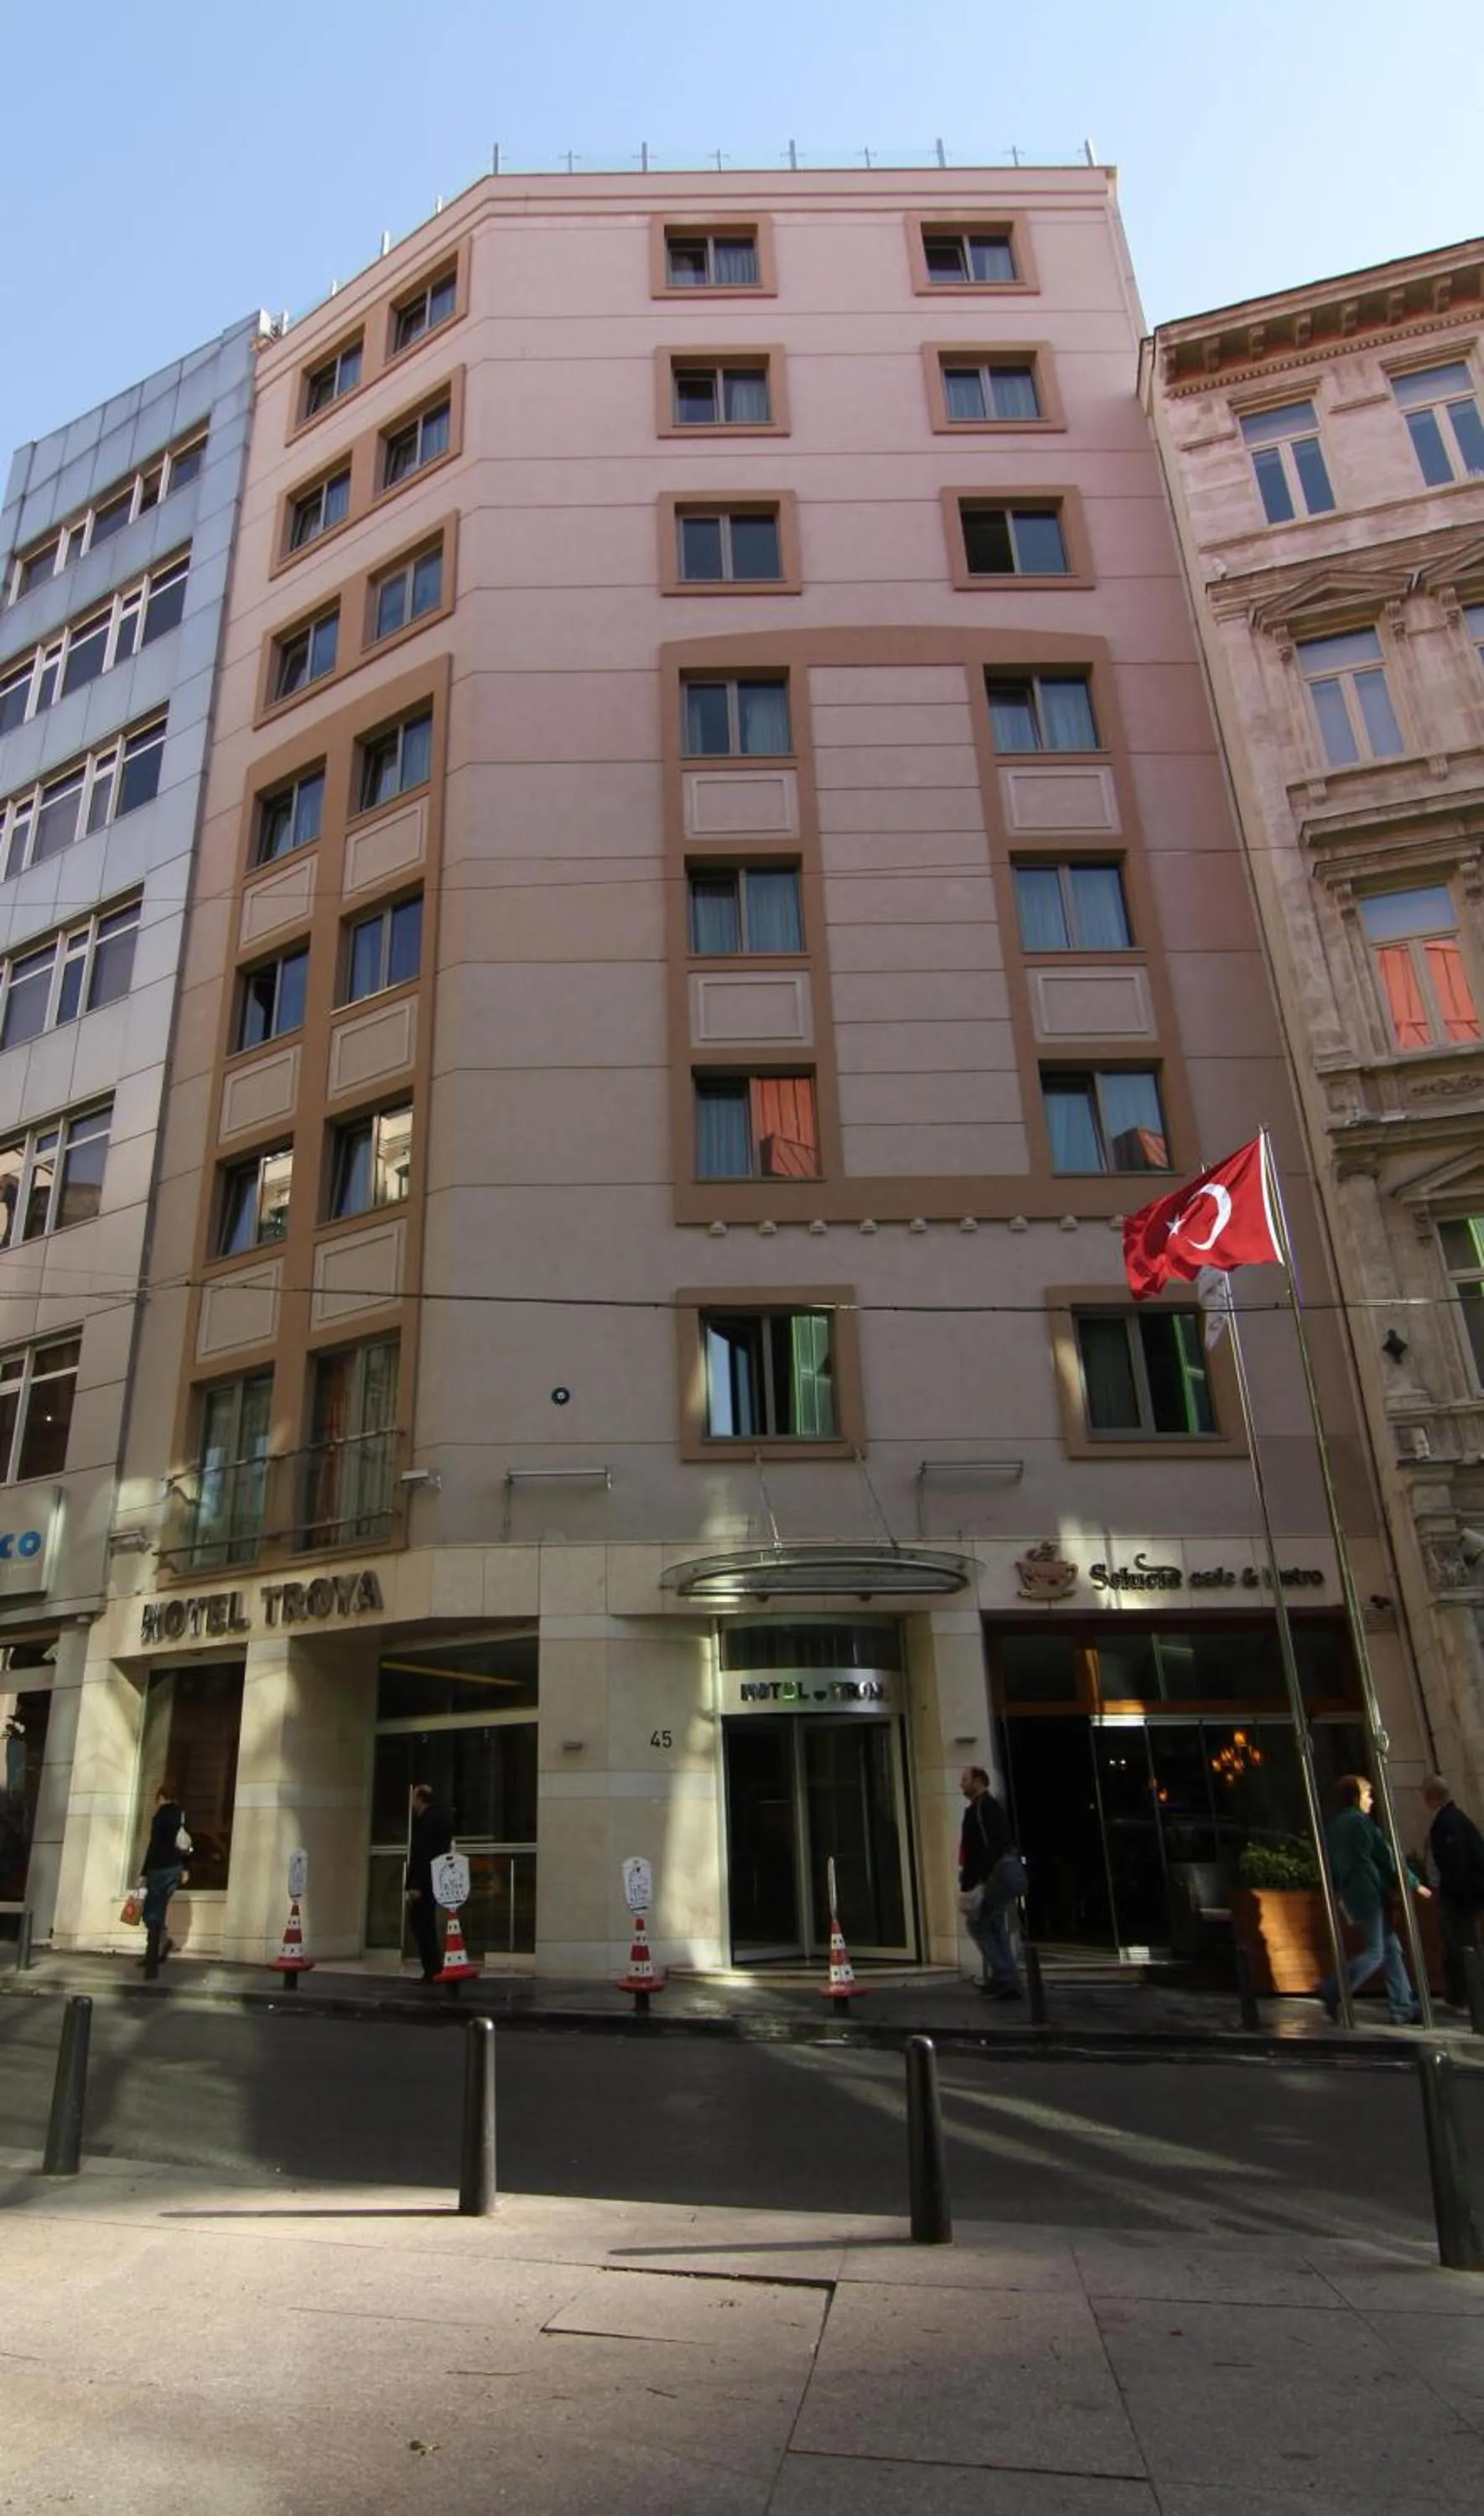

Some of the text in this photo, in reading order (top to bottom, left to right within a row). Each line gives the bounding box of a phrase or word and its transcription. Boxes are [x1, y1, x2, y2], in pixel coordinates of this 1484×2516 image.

[1262, 1567, 1325, 1589] bstro
[141, 1570, 384, 1646] HOTEL TROYA
[740, 1682, 809, 1702] HOTEL
[650, 1730, 672, 1749] 45
